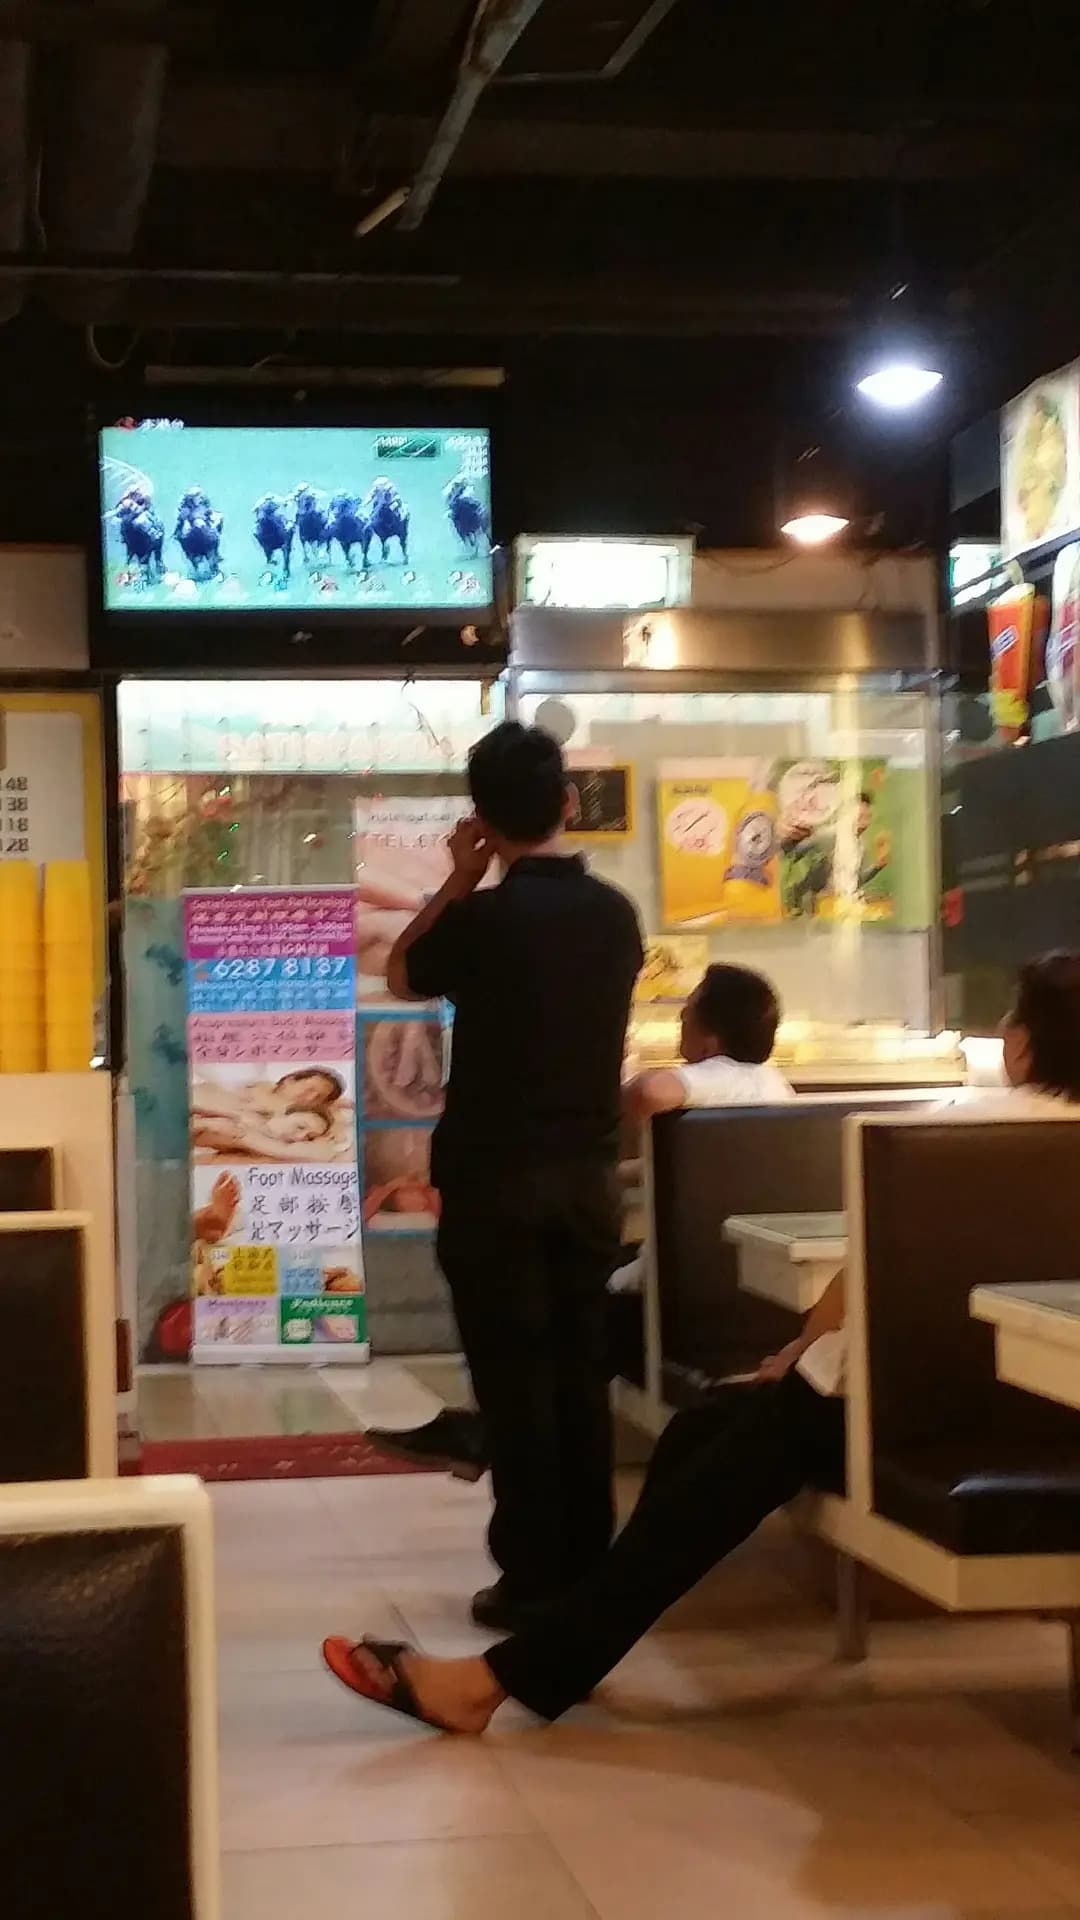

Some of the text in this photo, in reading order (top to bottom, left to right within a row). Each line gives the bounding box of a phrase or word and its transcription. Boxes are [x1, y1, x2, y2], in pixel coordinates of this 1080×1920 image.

[213, 958, 275, 979] 6287
[248, 1167, 358, 1190] Foot Massage
